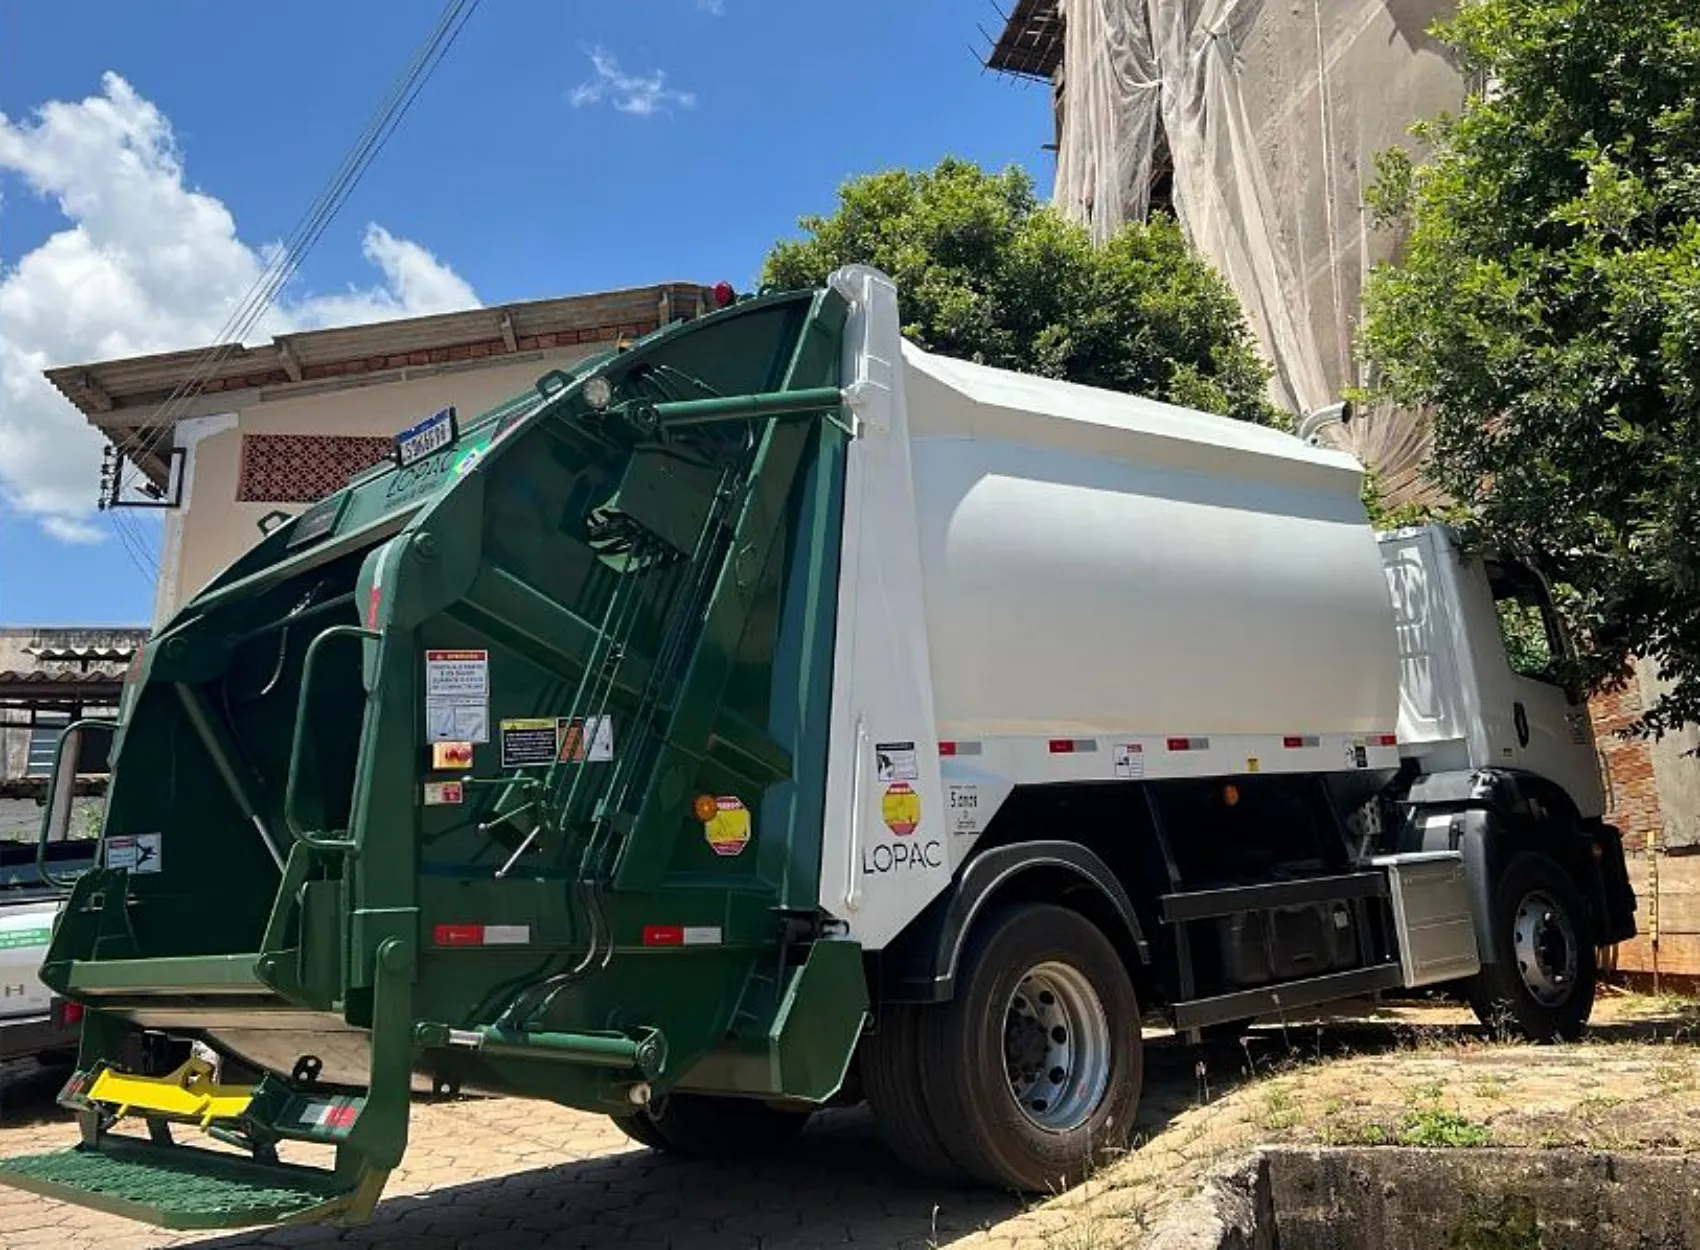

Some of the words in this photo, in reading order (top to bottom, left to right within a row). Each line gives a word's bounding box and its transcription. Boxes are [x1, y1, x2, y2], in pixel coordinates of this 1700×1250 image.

[386, 449, 456, 498] LOPAC
[950, 791, 957, 808] 5
[862, 840, 942, 874] LOPAC
